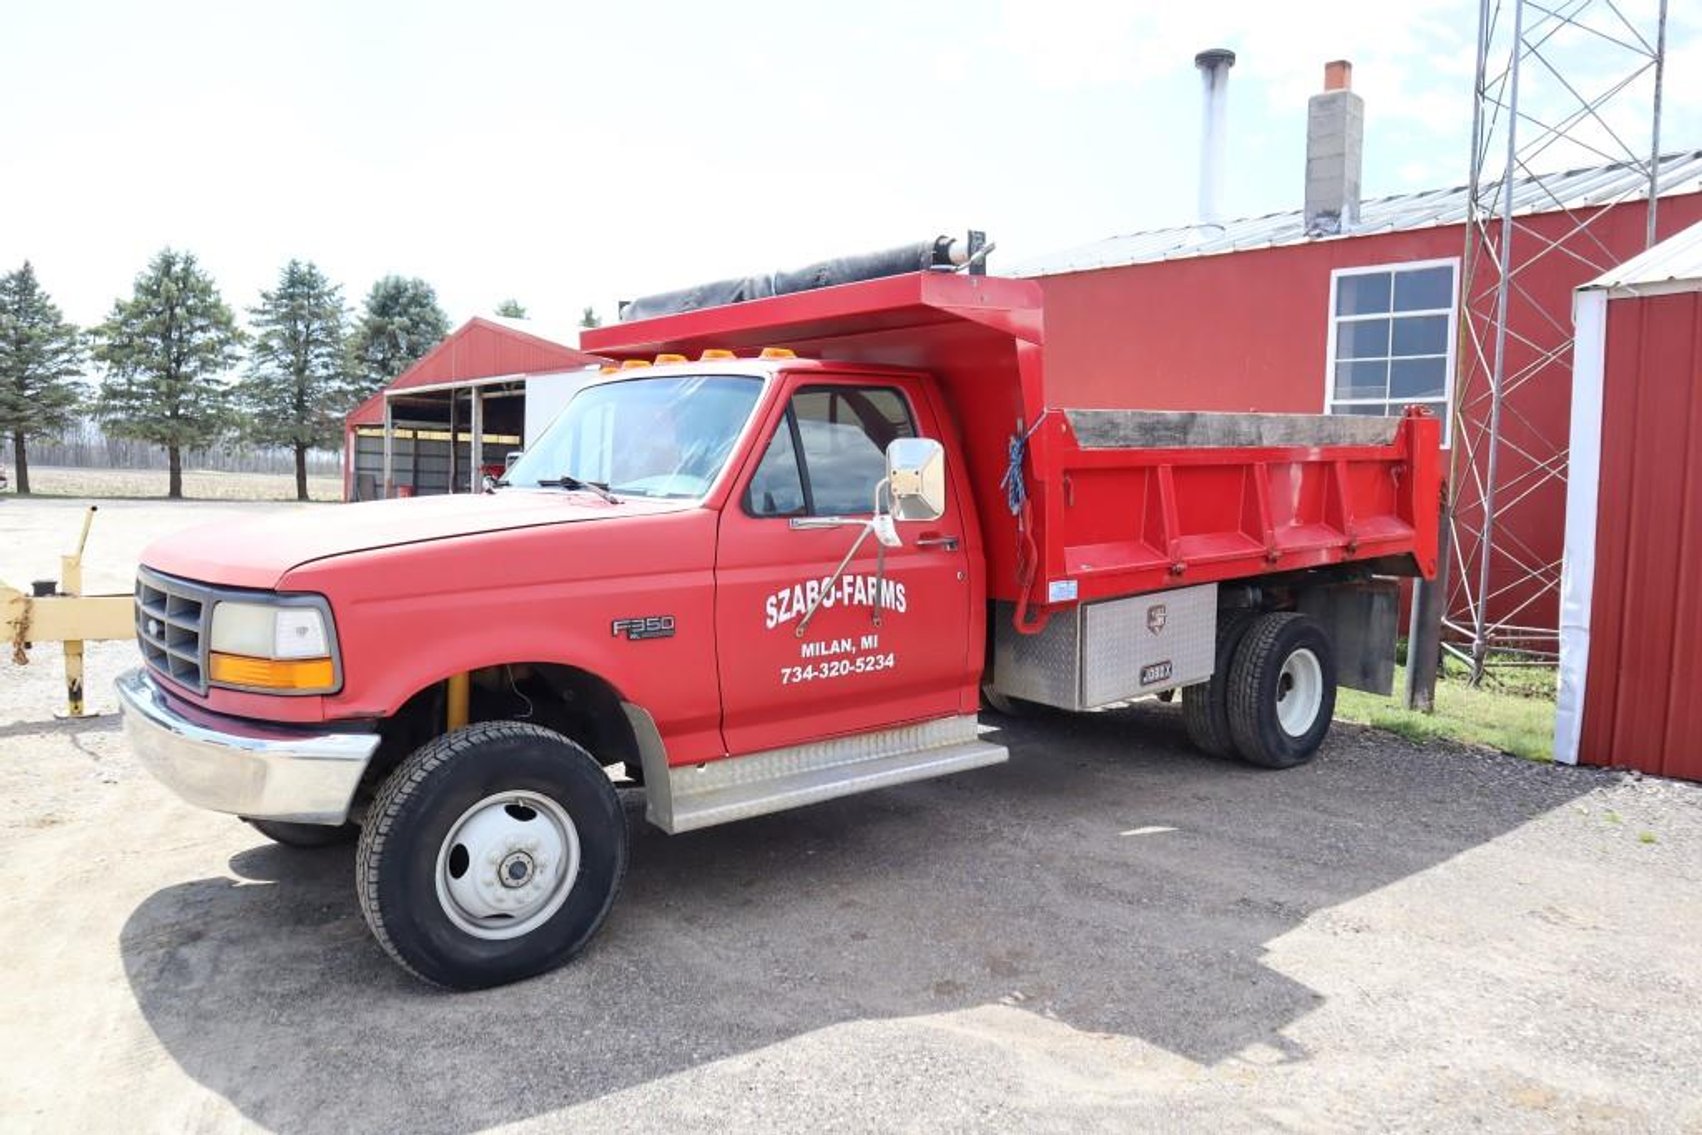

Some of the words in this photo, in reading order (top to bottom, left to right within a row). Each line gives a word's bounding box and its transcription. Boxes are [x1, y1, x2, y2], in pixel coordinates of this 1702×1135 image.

[766, 575, 906, 629] SZABO-FARMS
[802, 638, 856, 658] MILAN,
[861, 634, 878, 650] MI
[781, 653, 895, 685] 734-320-5234
